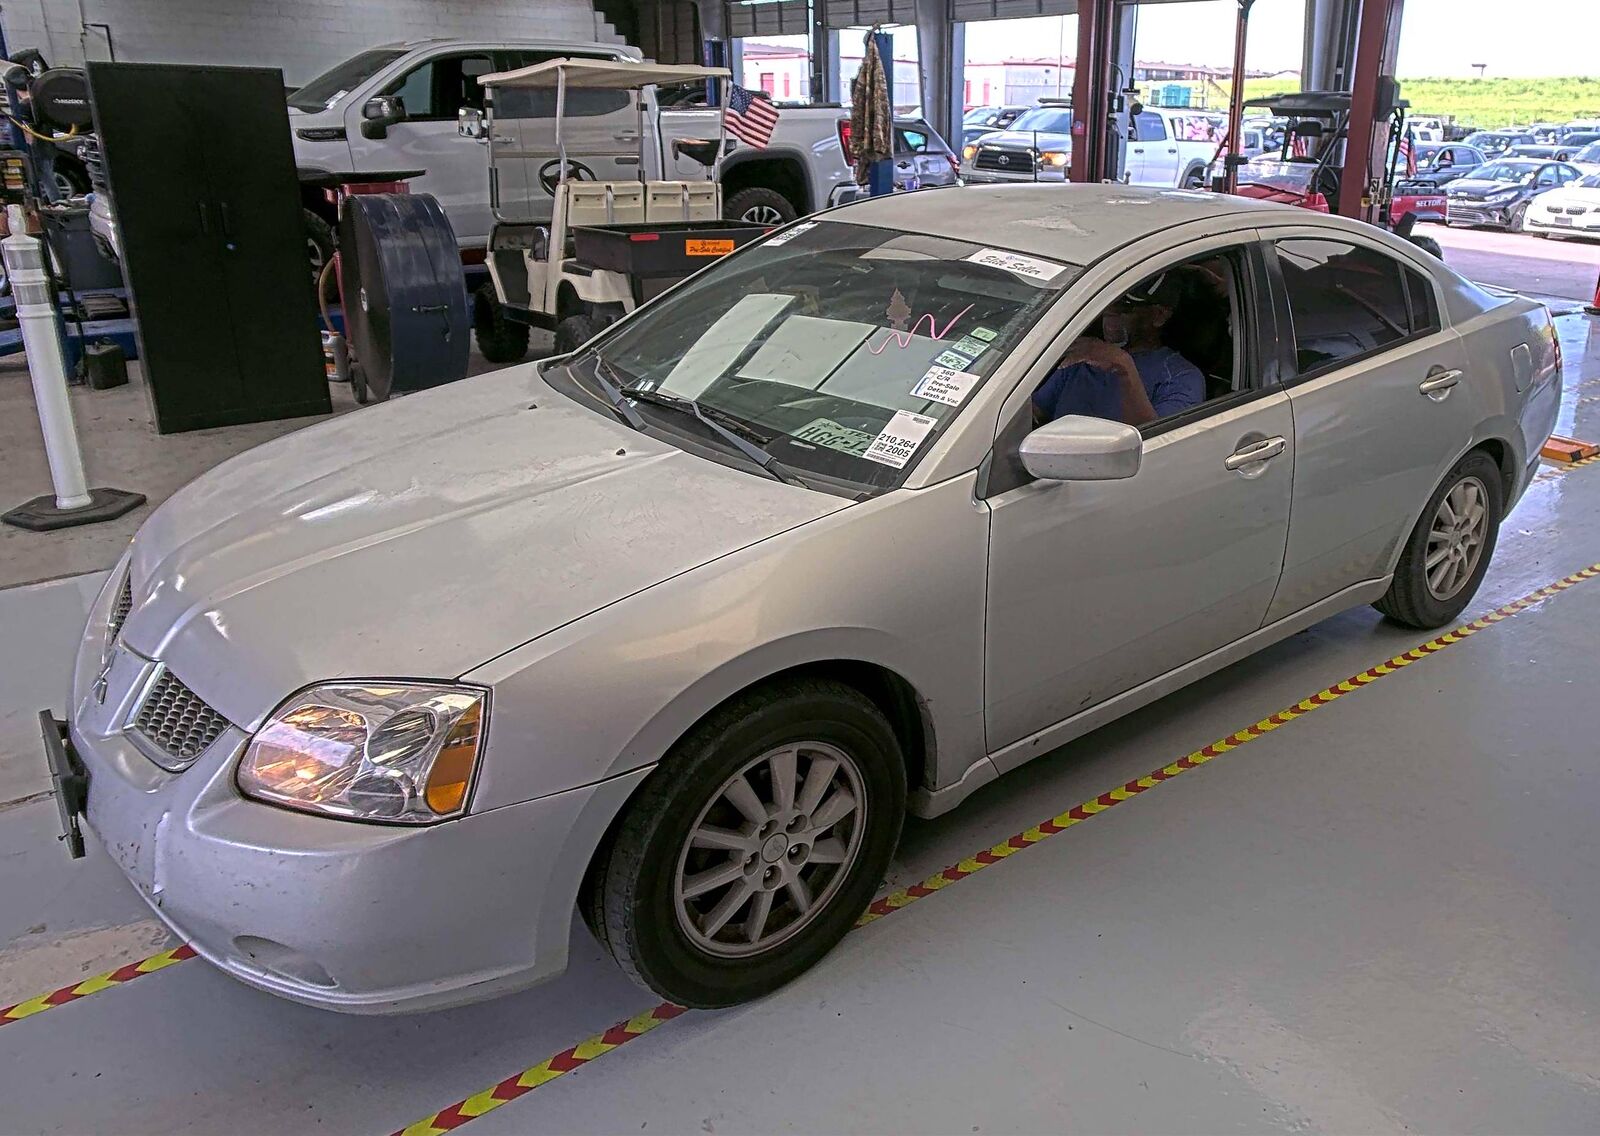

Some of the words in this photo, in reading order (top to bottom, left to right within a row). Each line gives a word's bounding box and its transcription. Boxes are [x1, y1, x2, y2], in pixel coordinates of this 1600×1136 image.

[936, 374, 951, 382] C/R
[940, 369, 956, 377] 360
[927, 385, 949, 395] Detail
[931, 380, 960, 391] Pre-Sale
[922, 391, 940, 400] Wash
[947, 397, 959, 405] Vac
[878, 433, 917, 450] 210,264
[886, 445, 911, 458] 2005
